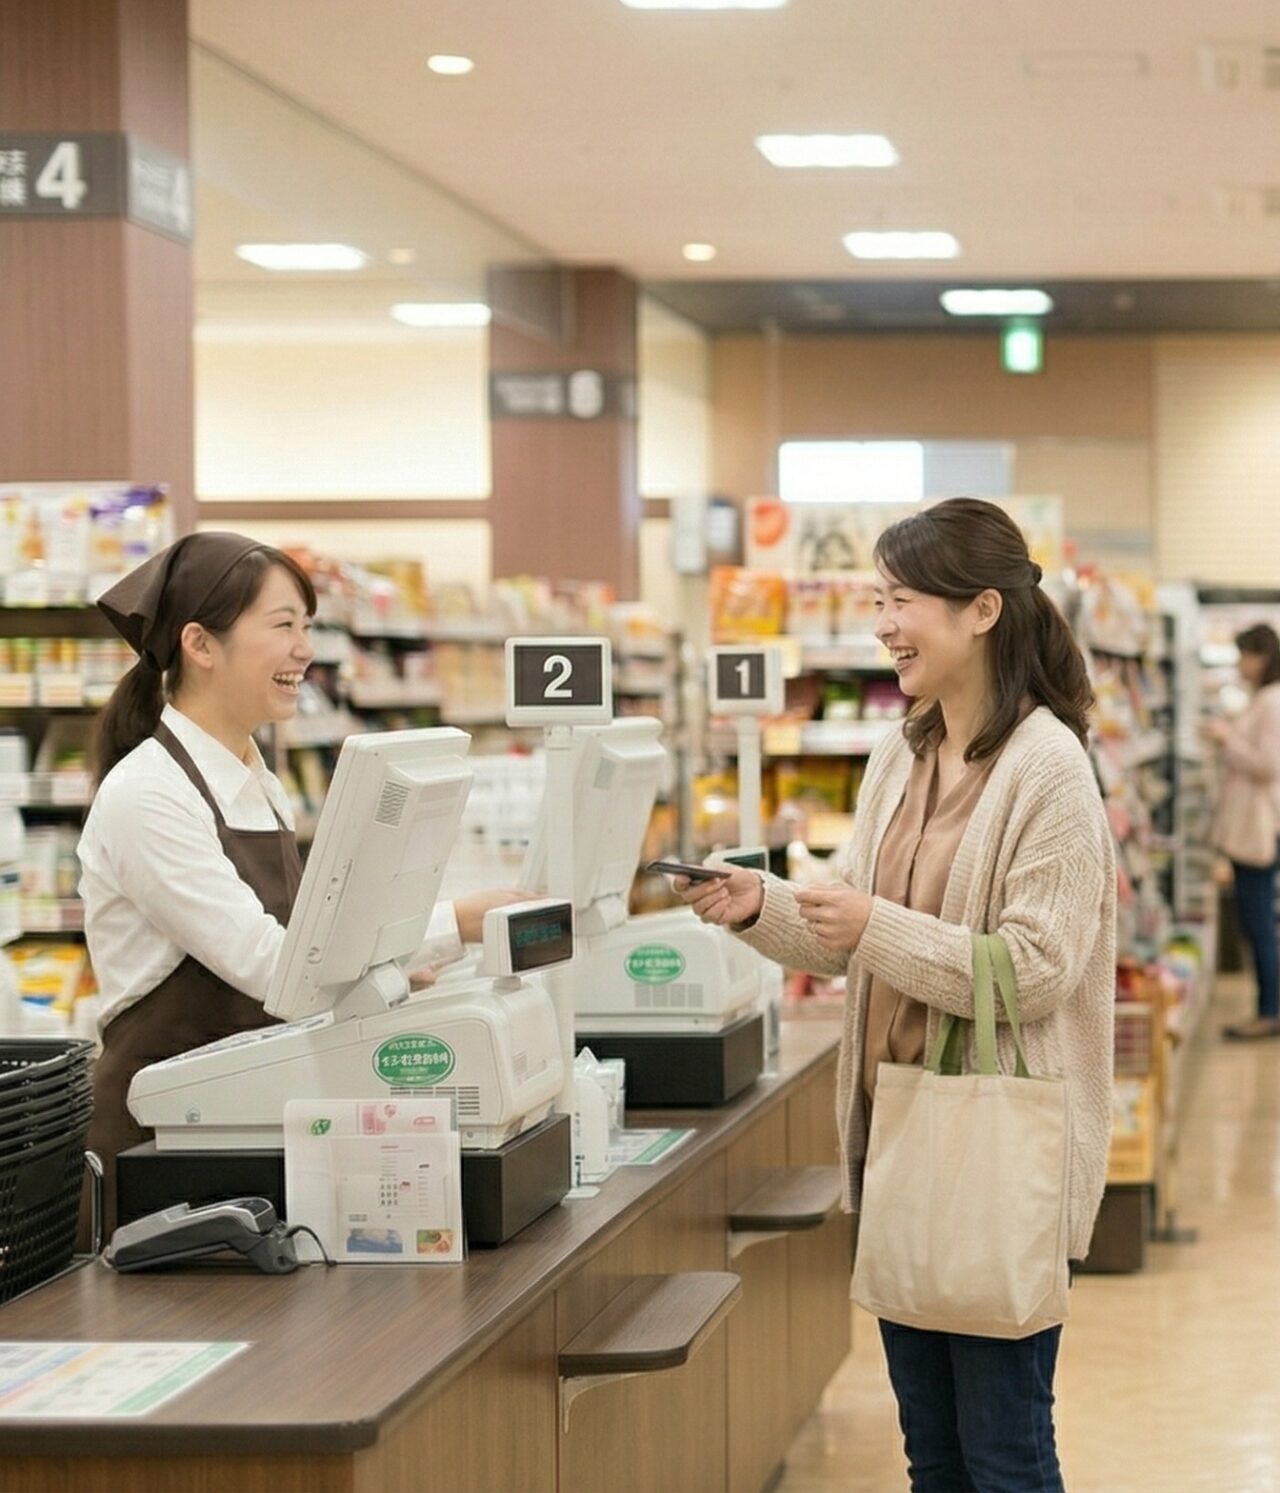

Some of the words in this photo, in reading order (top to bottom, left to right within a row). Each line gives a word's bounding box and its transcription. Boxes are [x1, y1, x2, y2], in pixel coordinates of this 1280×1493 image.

[36, 142, 87, 209] 4
[543, 654, 573, 698] 2
[735, 659, 750, 695] 1
